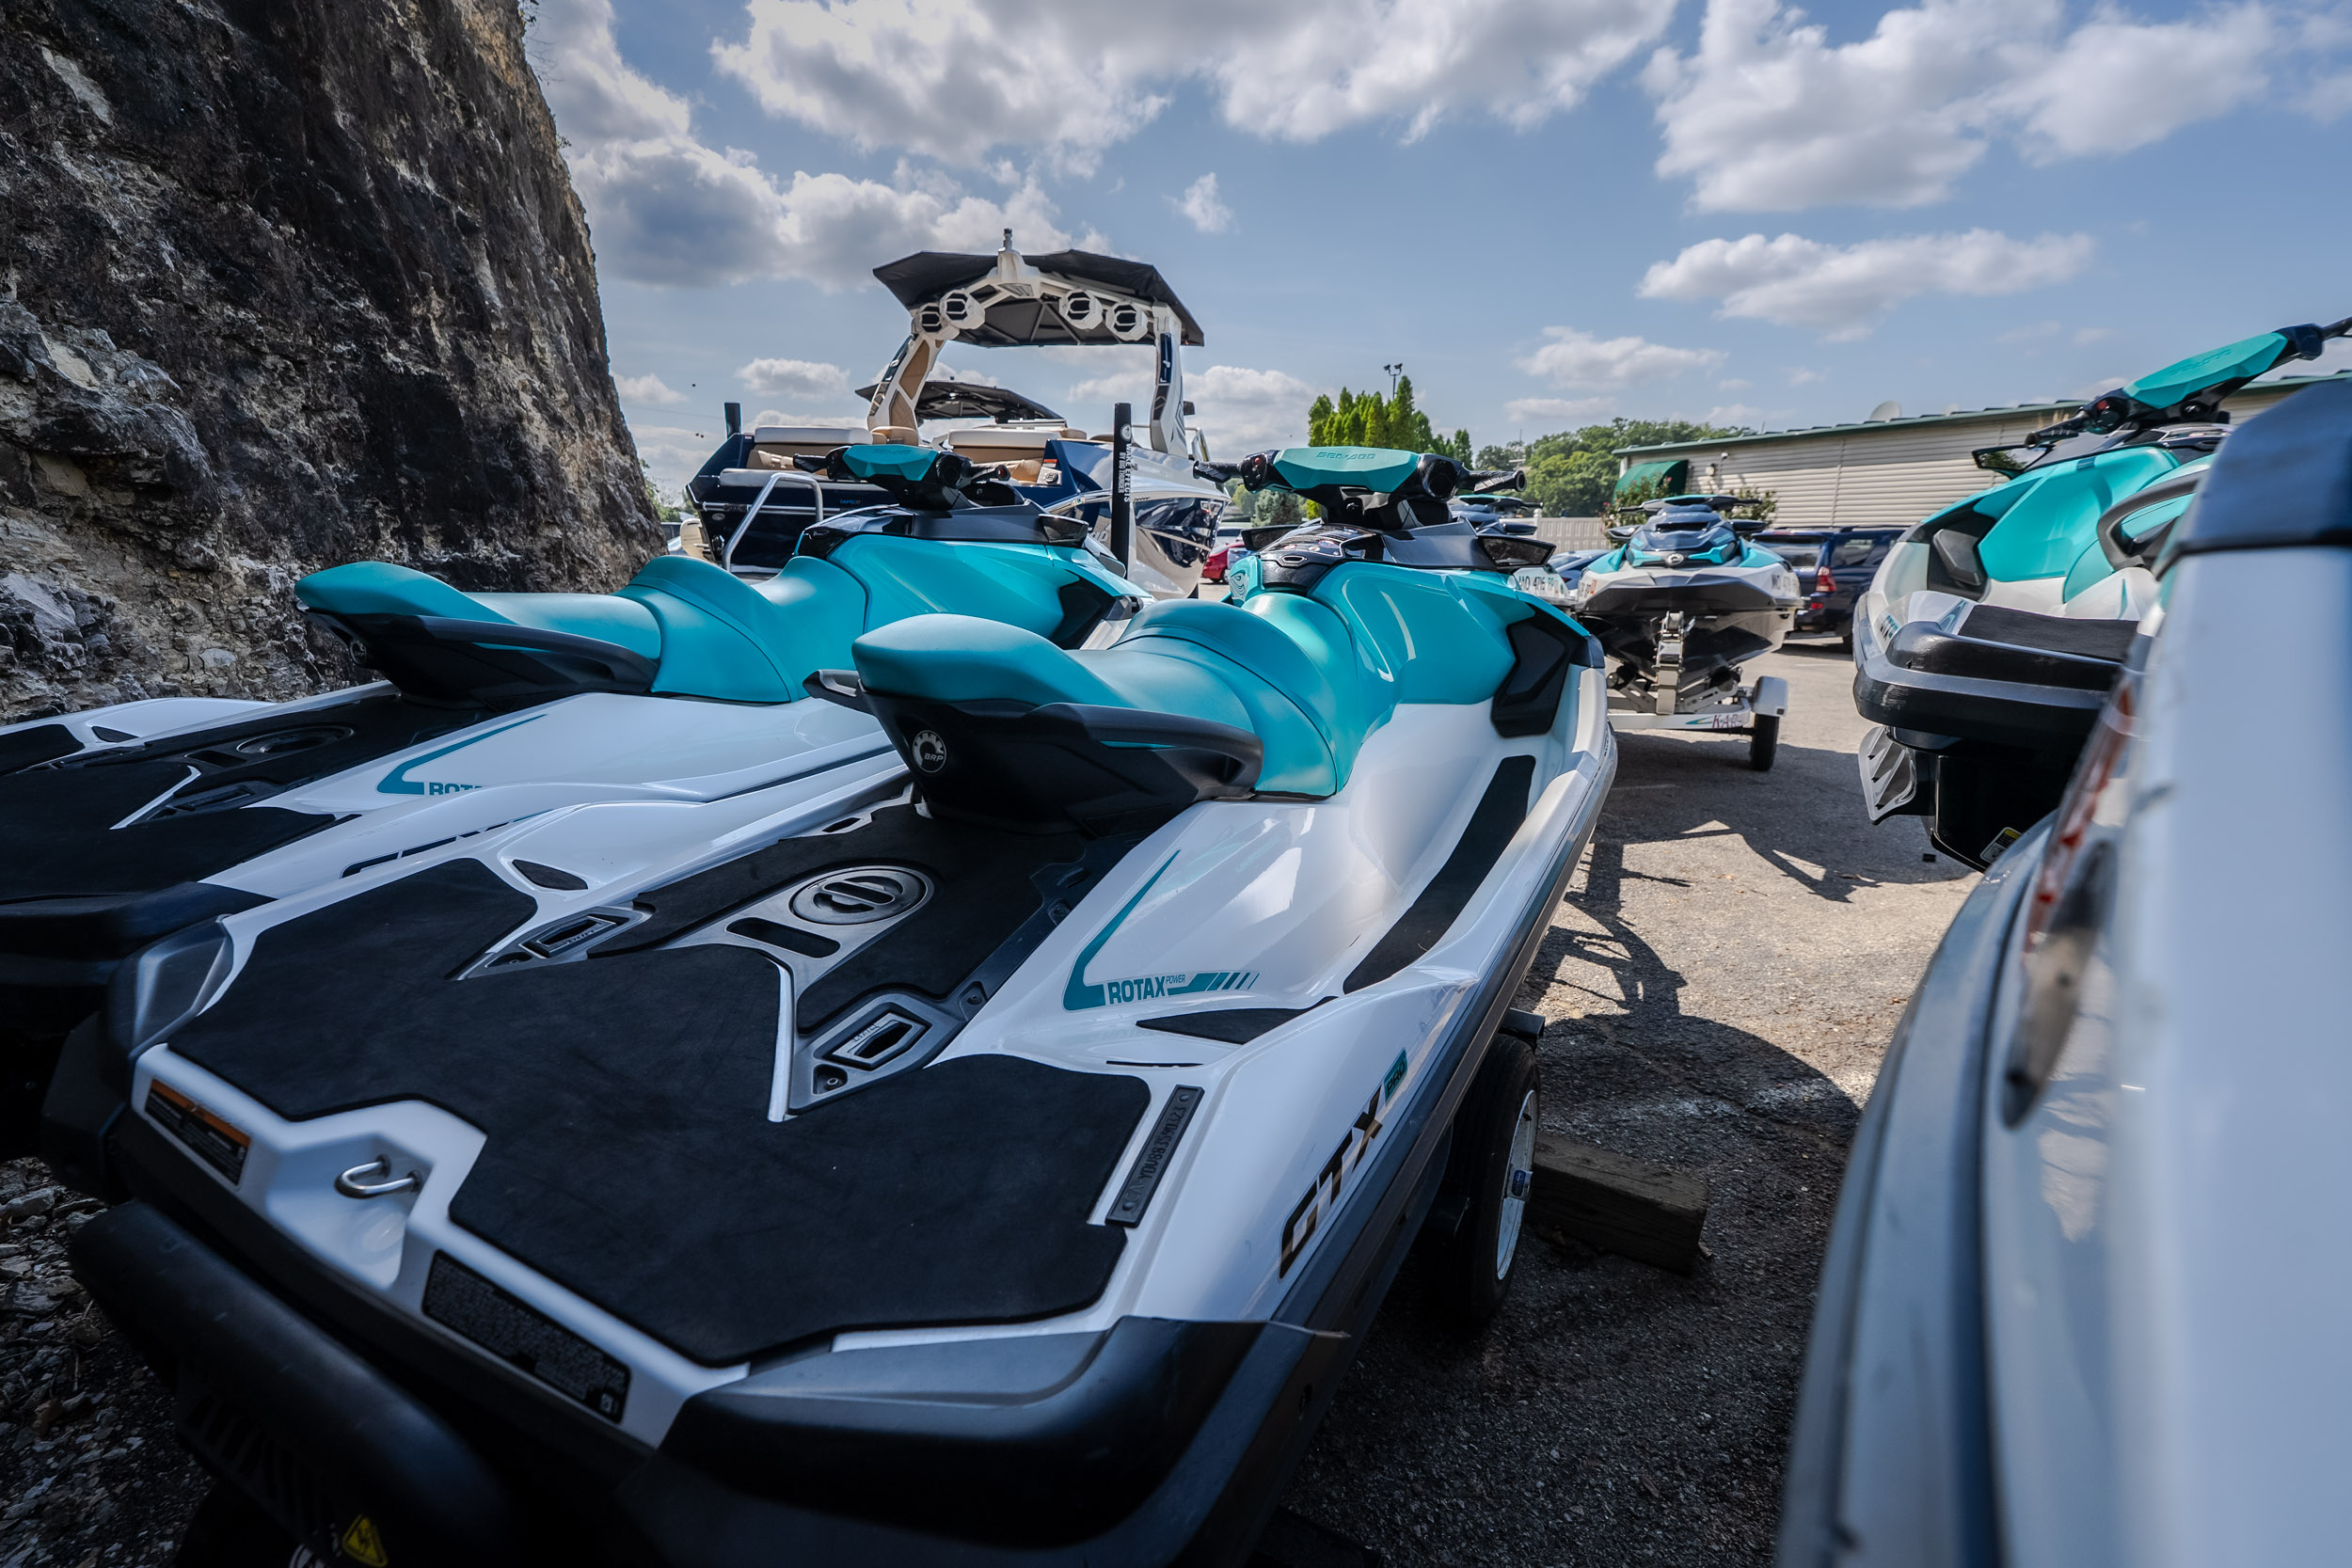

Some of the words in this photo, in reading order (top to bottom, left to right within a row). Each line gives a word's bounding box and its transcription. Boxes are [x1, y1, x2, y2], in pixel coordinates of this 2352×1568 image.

[924, 752, 944, 762] BRP
[1107, 975, 1166, 1005] ROTAX
[1166, 974, 1185, 984] POWER
[1279, 1085, 1383, 1280] GTX
[1386, 1060, 1406, 1100] PRO
